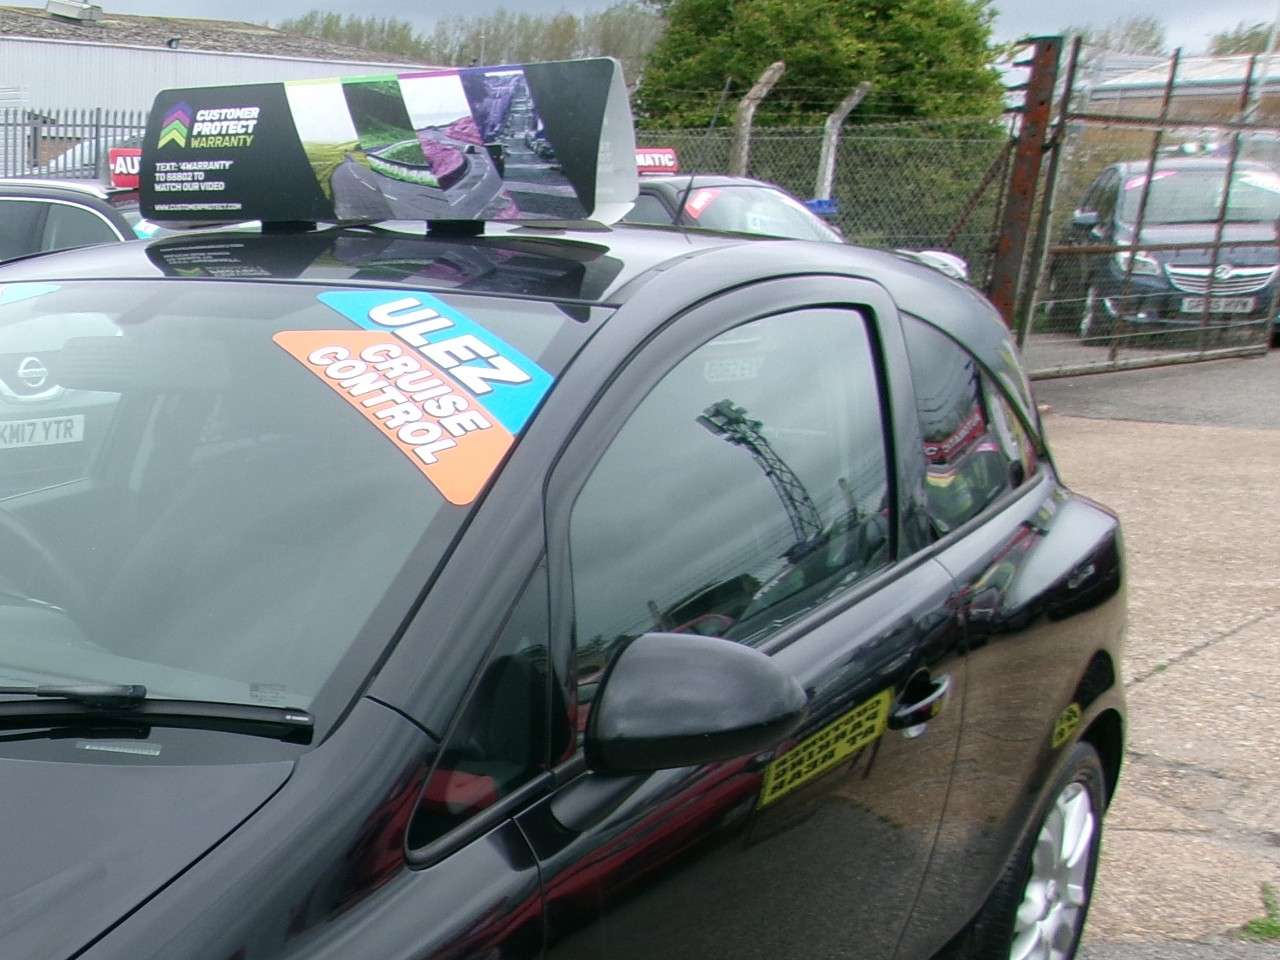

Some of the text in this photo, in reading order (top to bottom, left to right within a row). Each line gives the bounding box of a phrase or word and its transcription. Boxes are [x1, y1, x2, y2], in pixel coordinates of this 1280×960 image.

[196, 107, 260, 121] CUSTOMER
[192, 120, 257, 135] PROTECT
[190, 135, 255, 148] WARRANTY
[154, 181, 225, 192] WATCH OUR VIDEO
[369, 297, 533, 395] ULEZ
[360, 343, 492, 437] CRUISE
[308, 345, 457, 465] CONTROL
[42, 419, 74, 441] YTR
